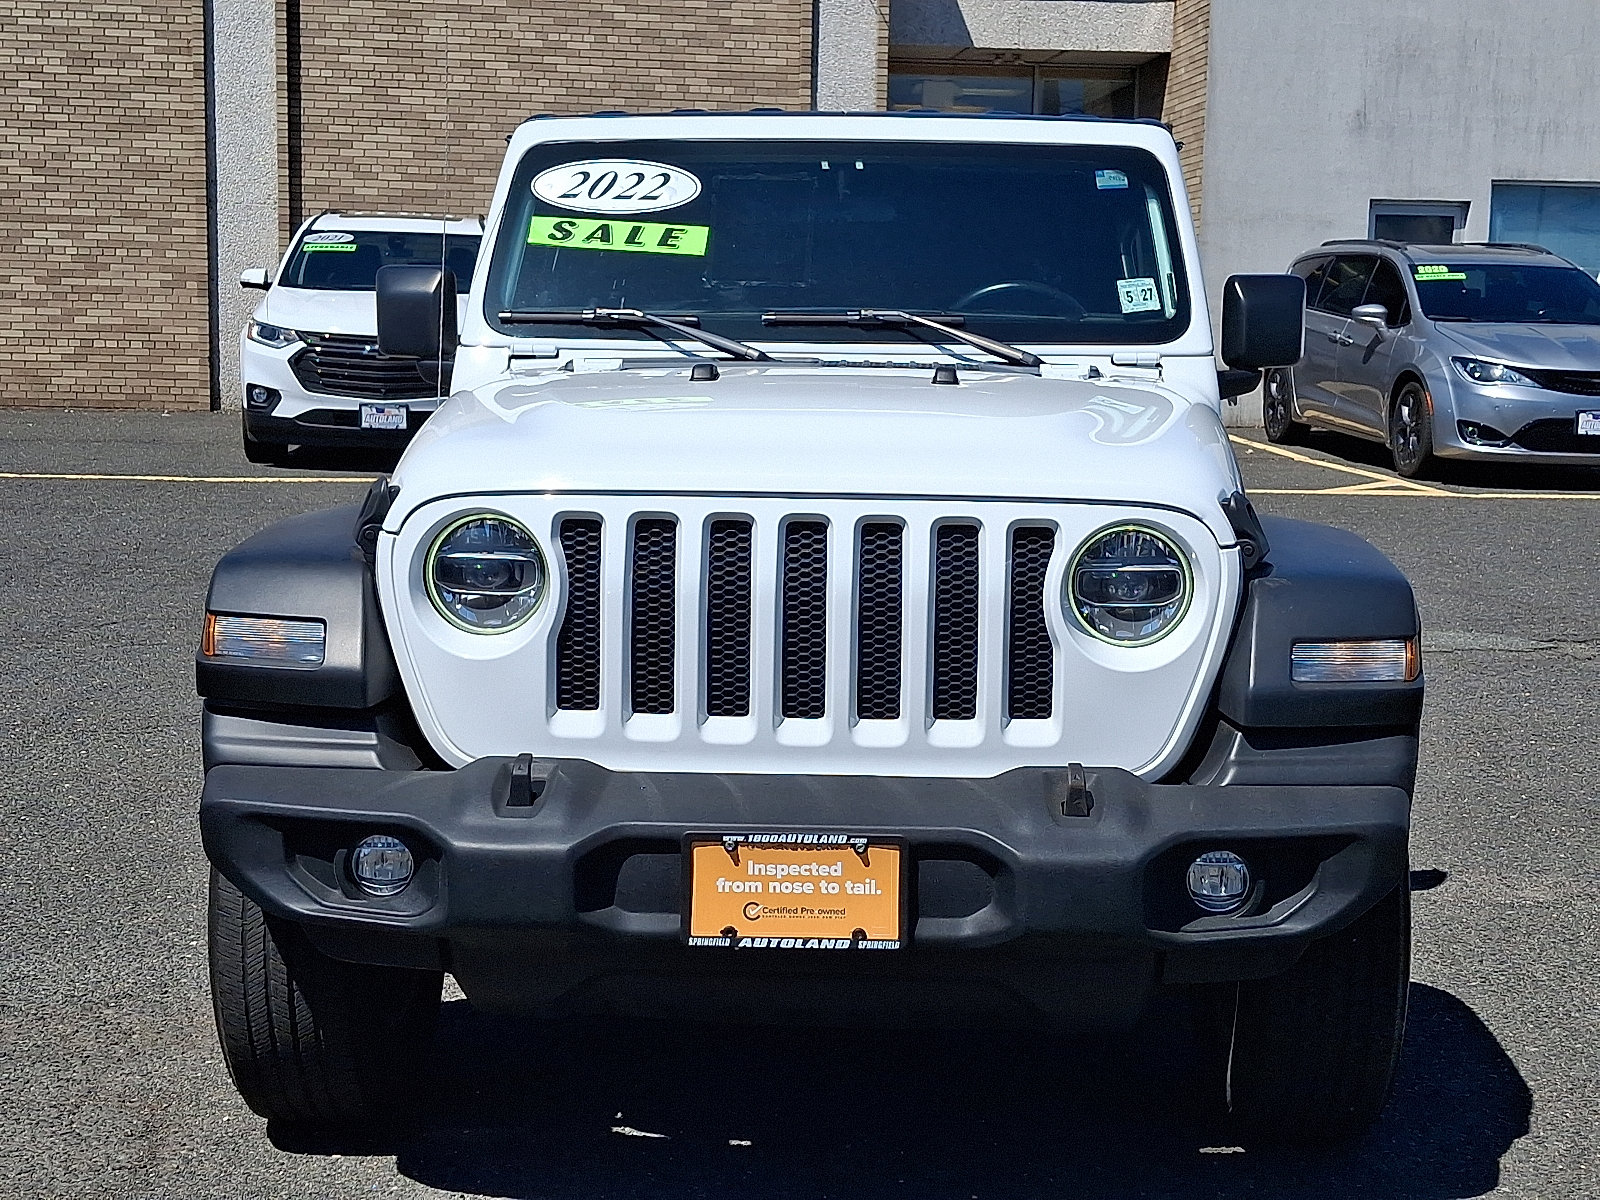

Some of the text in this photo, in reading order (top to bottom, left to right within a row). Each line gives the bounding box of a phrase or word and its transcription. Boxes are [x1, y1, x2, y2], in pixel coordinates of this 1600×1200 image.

[556, 170, 671, 200] 2022
[548, 220, 688, 249] SALE
[1125, 287, 1153, 304] 5 27
[364, 413, 404, 424] AUTOLAND
[747, 860, 842, 878] Inspected
[716, 878, 882, 895] from nose to tail.
[762, 906, 798, 915] Certified
[688, 937, 730, 947] SPRINGFIELD
[738, 938, 851, 949] AUTOLAND
[858, 940, 900, 950] SPRINGFIELD
